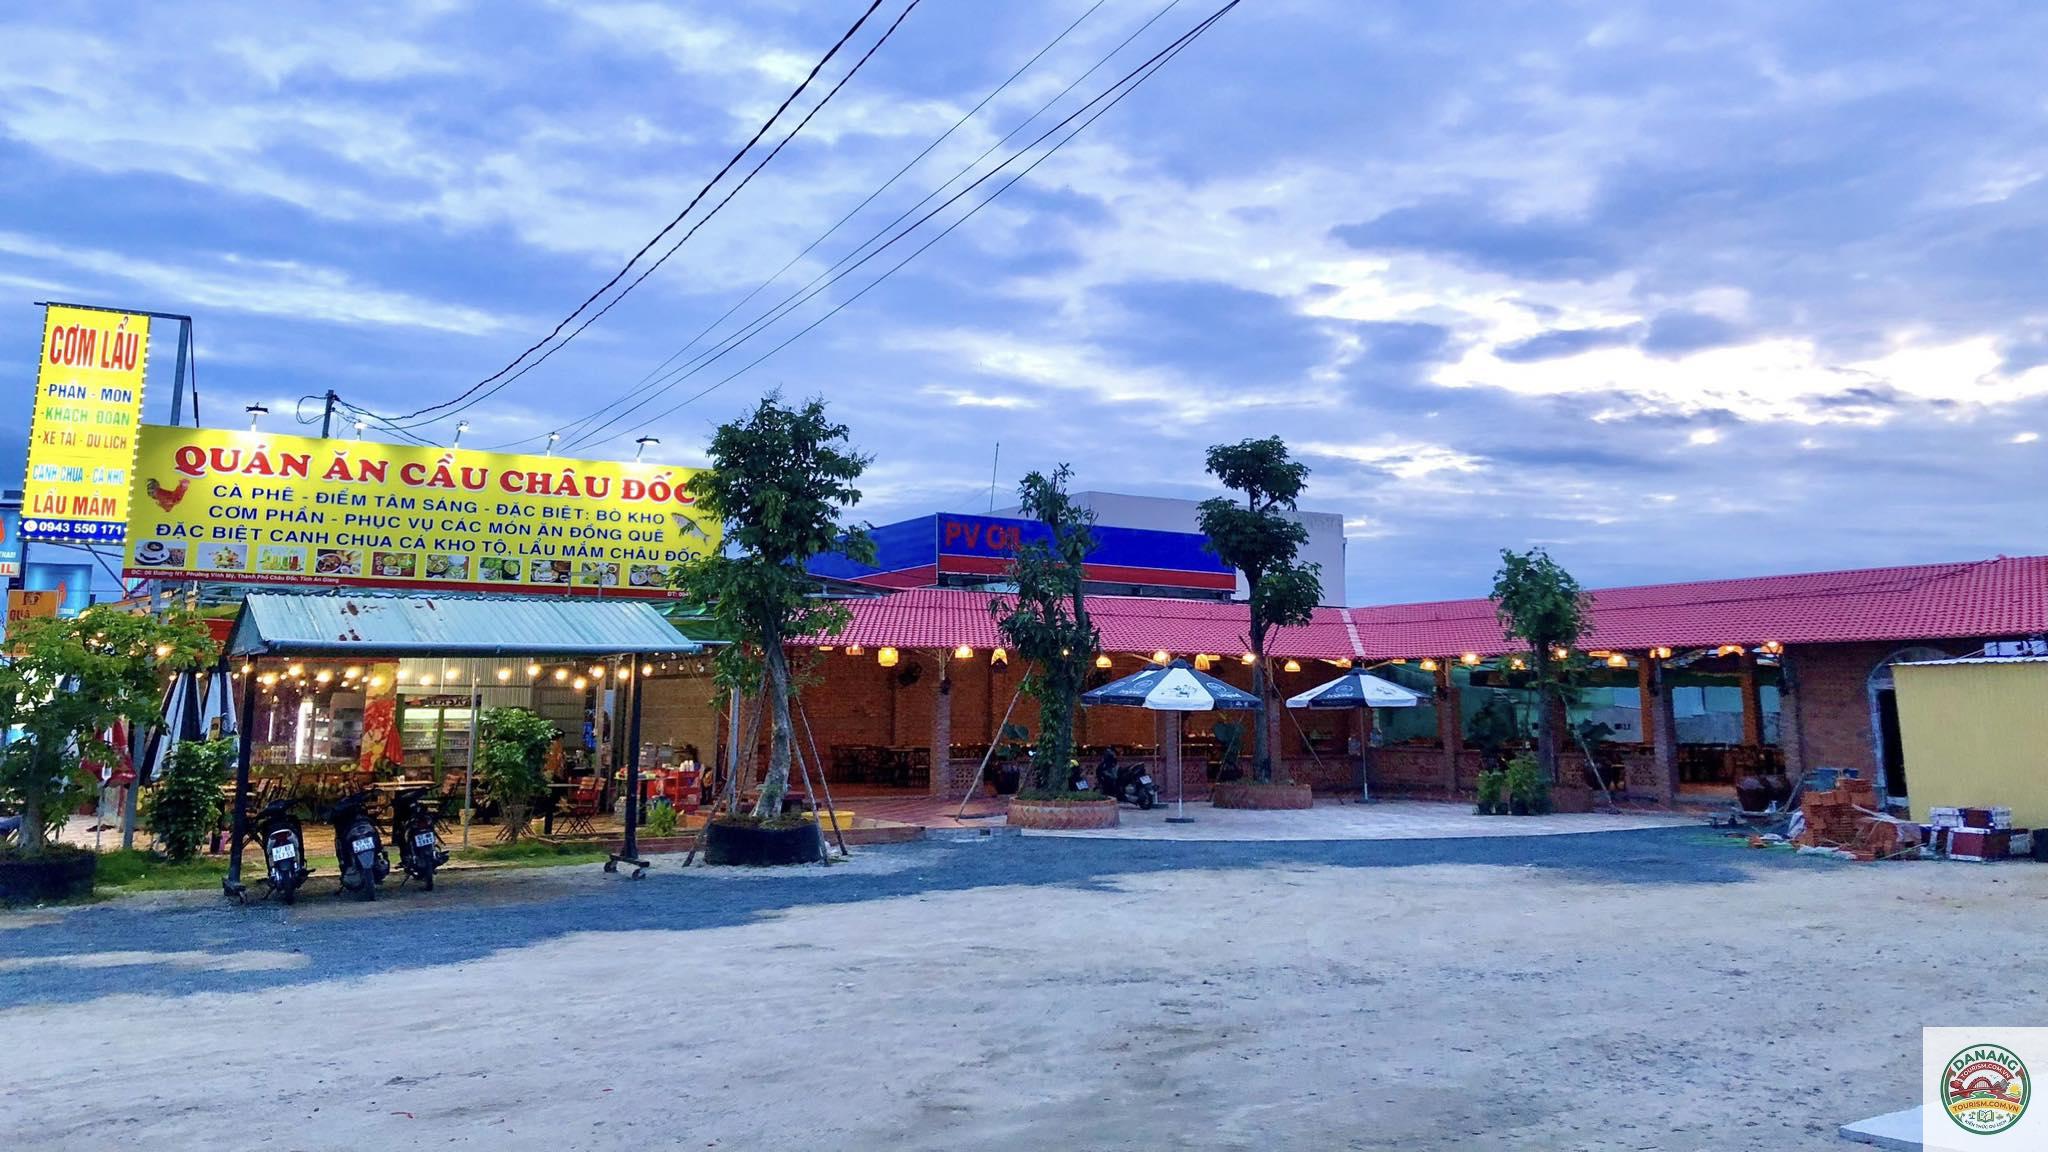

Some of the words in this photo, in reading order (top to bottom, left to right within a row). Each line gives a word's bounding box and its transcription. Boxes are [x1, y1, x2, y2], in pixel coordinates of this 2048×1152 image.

[50, 324, 96, 366] CƠM
[60, 466, 83, 482] CHUA
[175, 444, 312, 478] QUÁN
[322, 450, 388, 483] ĂN
[400, 453, 488, 490] CẦU
[500, 468, 610, 499] CHÂU
[621, 472, 695, 504] ĐỐC
[209, 505, 257, 520] CƠM
[266, 506, 324, 524] PHẦN
[345, 513, 400, 530] PHỤC
[408, 518, 434, 533] VỤ
[441, 518, 481, 533] CÁC
[489, 520, 531, 536] MÓN
[537, 522, 563, 537] ĂN
[570, 524, 622, 541] ĐỒNG
[628, 529, 664, 543] QUÊ
[213, 483, 242, 499] CÀ
[252, 487, 294, 502] PHÊ
[316, 488, 366, 507] ĐIỂM
[374, 494, 415, 510] TÂM
[423, 497, 478, 514] SÁNG
[496, 502, 535, 519] ĐẶC
[542, 505, 589, 522] BIỆT:
[596, 508, 621, 523] BÒ
[628, 511, 665, 525] KHO
[39, 522, 70, 533] 0943
[73, 524, 97, 534] 550
[101, 525, 122, 535] 171
[156, 521, 204, 539] ĐẶC
[213, 524, 262, 543] BIỆT
[270, 529, 329, 544] CANH
[336, 532, 392, 548] CHUA
[400, 535, 426, 550] CÁ
[434, 538, 476, 551] KHO
[519, 538, 555, 556] LẨU
[562, 541, 604, 558] MẮM
[610, 546, 660, 562] CHÂU
[665, 547, 701, 563] ĐỐC
[945, 521, 980, 549] PV
